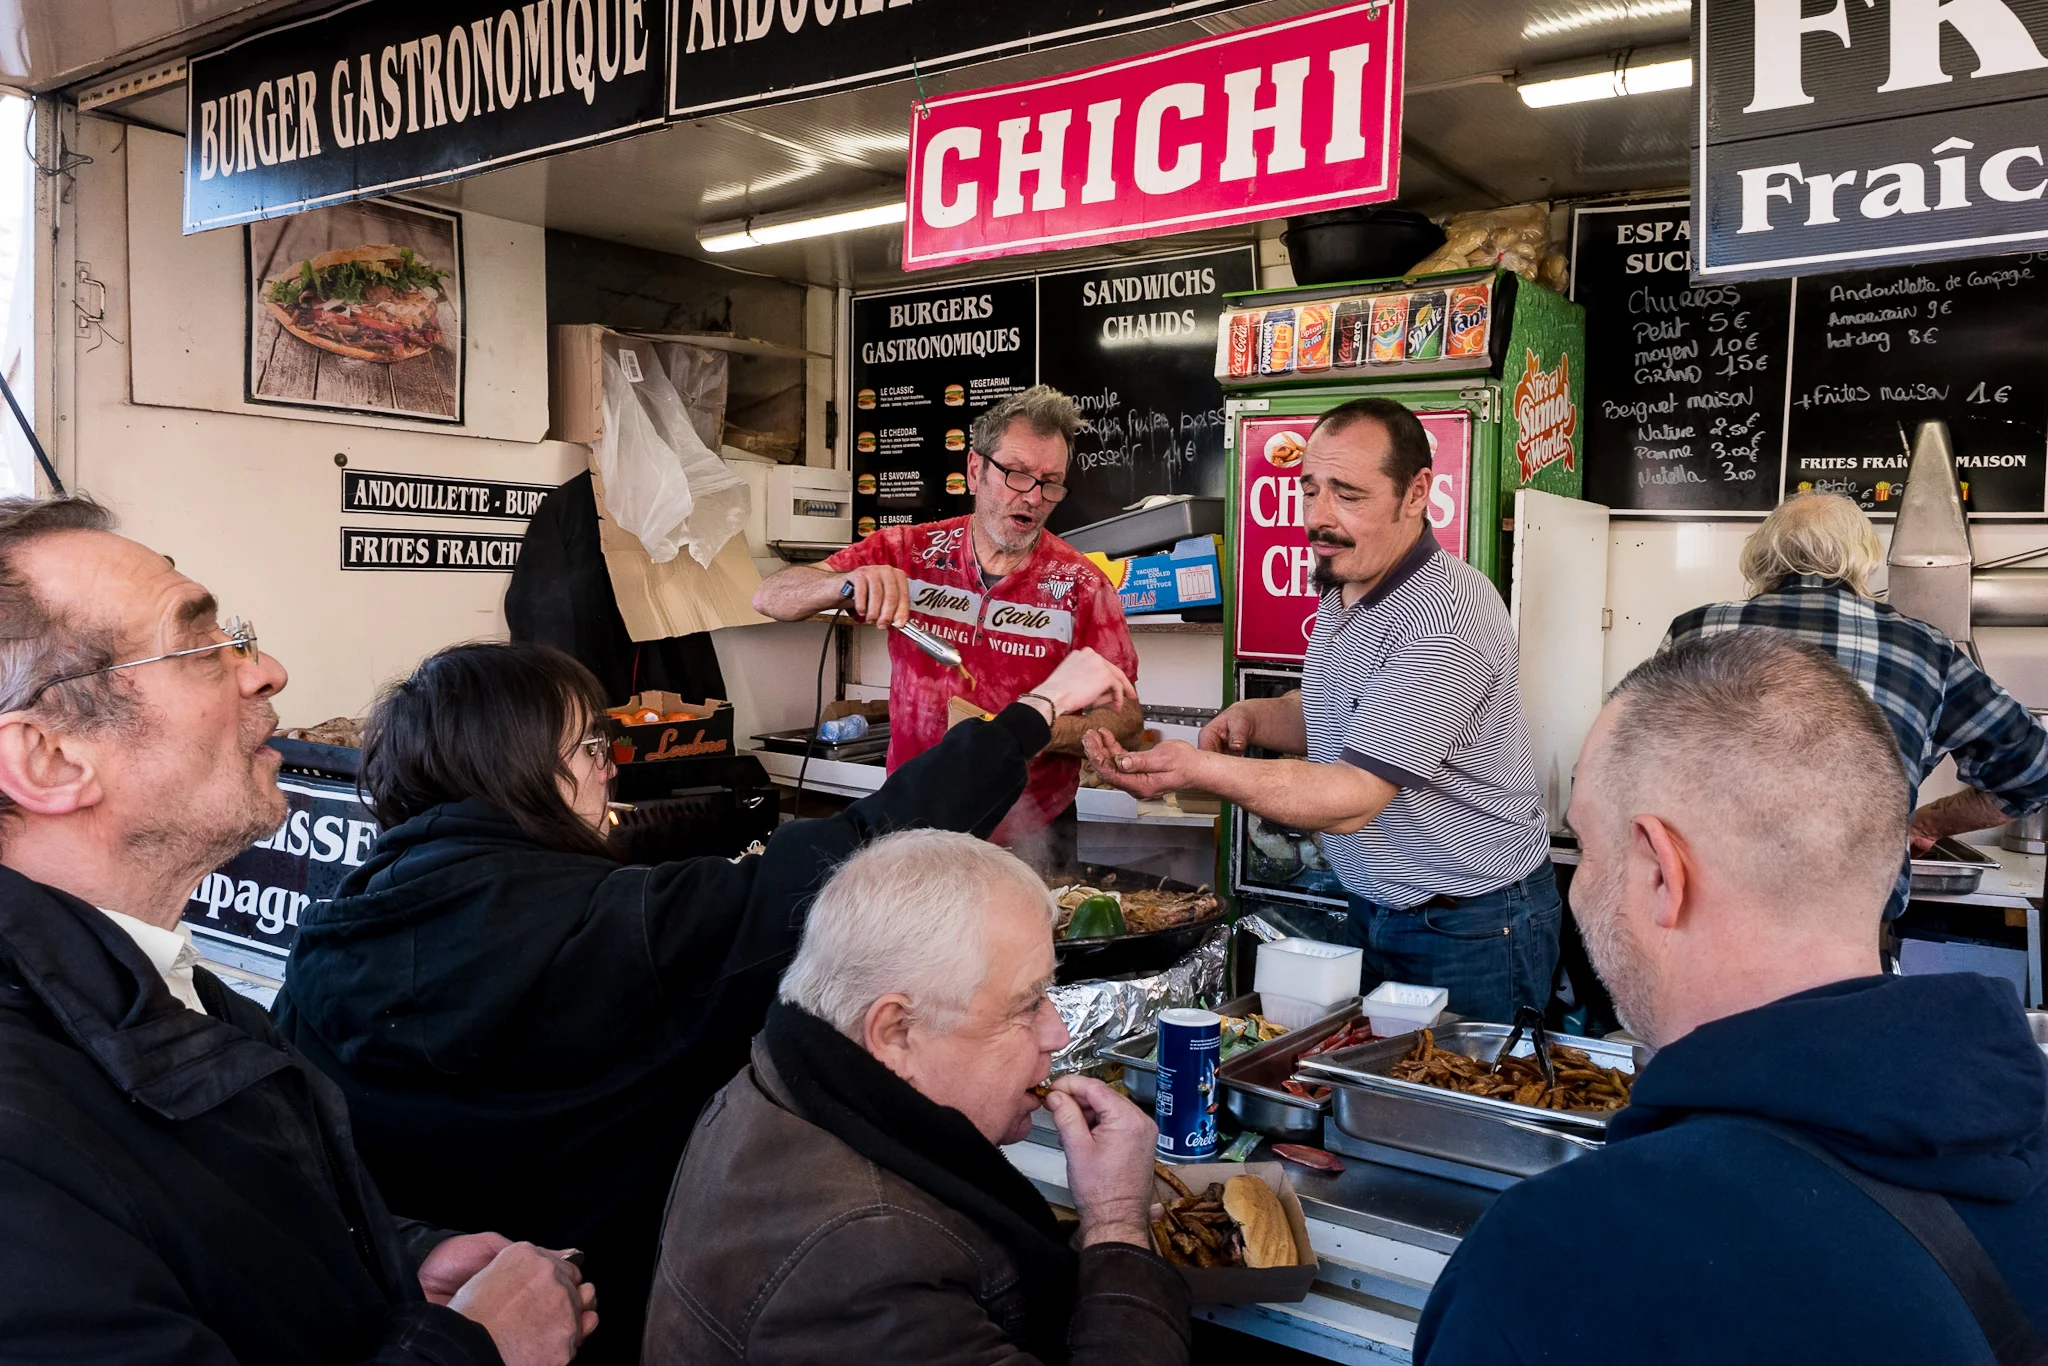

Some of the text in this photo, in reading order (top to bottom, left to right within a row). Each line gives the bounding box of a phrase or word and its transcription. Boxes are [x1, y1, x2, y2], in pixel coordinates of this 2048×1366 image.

[199, 70, 321, 181] BURGER
[331, 0, 648, 149] GASTRONOMIQUE
[921, 42, 1371, 229] CHICHI
[1083, 268, 1216, 306] SANDWICHS
[1946, 275, 1962, 288] de
[889, 294, 993, 328] BURGERS
[1372, 310, 1407, 335] Oasis
[1103, 309, 1196, 341] CHAUDS
[1353, 321, 1361, 348] zero
[1408, 307, 1443, 354] Sprite
[1632, 316, 1690, 344] Petit
[862, 327, 1020, 365] GASTRONOMIQUES
[880, 386, 914, 396] LE CLASSIC
[970, 377, 1010, 388] VEGETARIAN
[1602, 392, 1679, 423] Beignet
[880, 427, 917, 437] LE CHEDDAR
[1638, 424, 1697, 442] Nature
[1800, 457, 1858, 469] FRITES
[1955, 454, 2027, 469] MAISON
[880, 471, 920, 480] LE SAVOYARD
[1637, 464, 1707, 488] Nutella
[353, 479, 490, 513] ANDOUILLETTE
[880, 515, 912, 524] LE BASQUE
[349, 536, 430, 564] FRITES
[1147, 581, 1172, 589] LETTUCE
[1148, 570, 1170, 578] COOLED
[913, 588, 1050, 629] Monte Carlo
[988, 637, 1046, 658] WORLD
